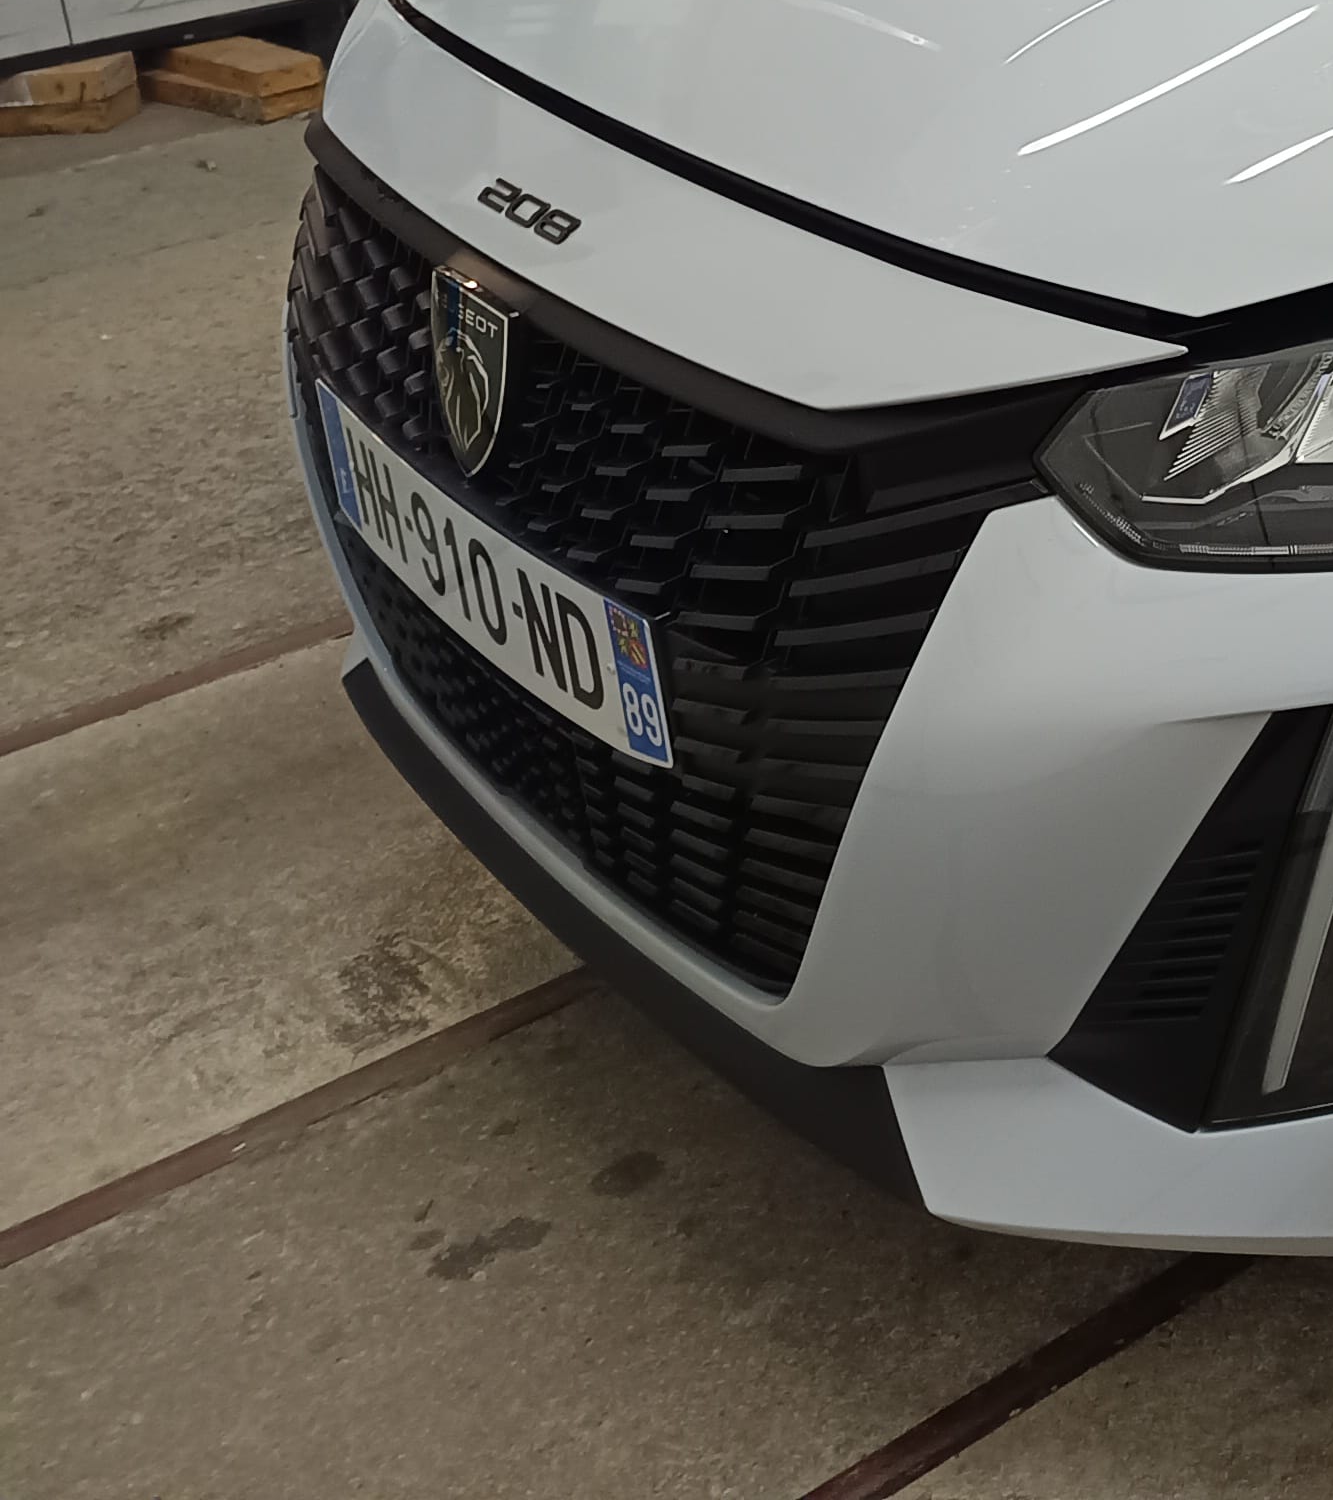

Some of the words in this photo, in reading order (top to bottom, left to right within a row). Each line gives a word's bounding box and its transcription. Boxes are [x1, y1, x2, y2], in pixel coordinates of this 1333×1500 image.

[477, 177, 582, 245] 208
[437, 291, 498, 339] EGEOT
[346, 427, 604, 710] HH-910-ND
[622, 682, 663, 748] 89
